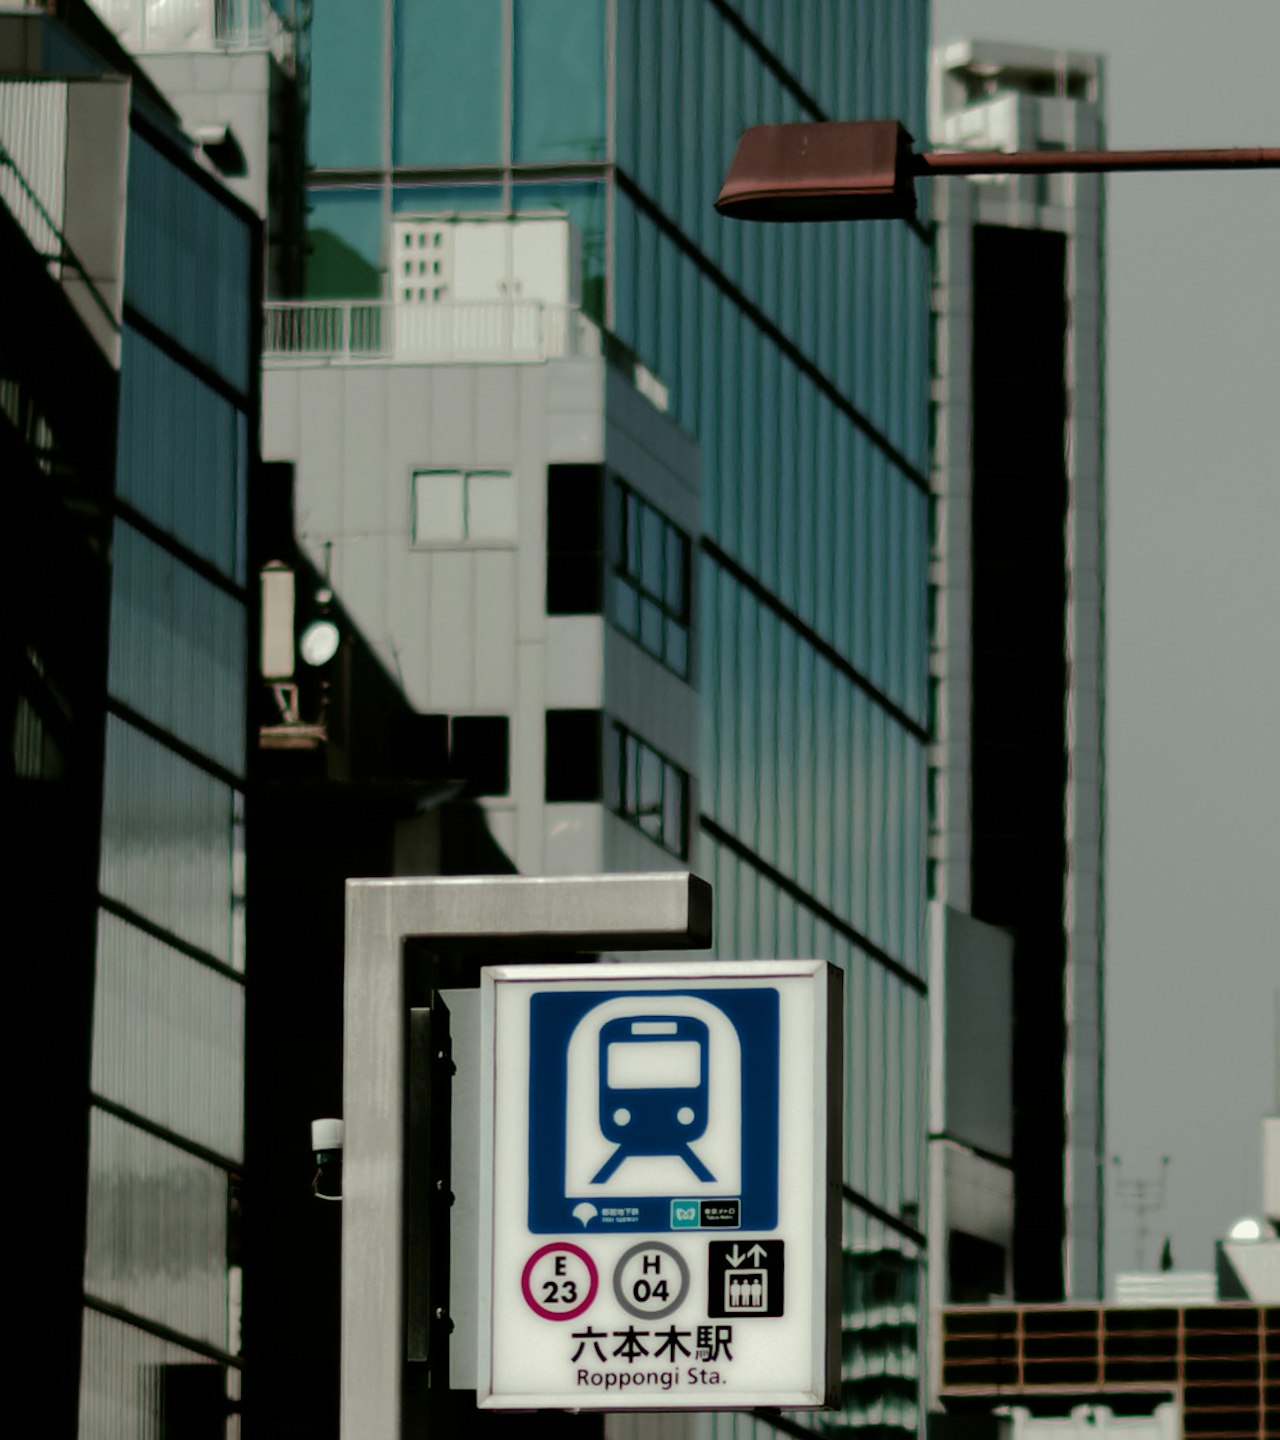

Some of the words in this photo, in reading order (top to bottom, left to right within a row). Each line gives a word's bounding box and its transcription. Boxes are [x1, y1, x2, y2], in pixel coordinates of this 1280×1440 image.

[555, 1256, 566, 1275] E
[643, 1256, 660, 1274] H
[542, 1281, 577, 1303] 23
[633, 1279, 669, 1302] 04
[571, 1324, 733, 1363] 六本木駅
[576, 1367, 680, 1391] Roppongi
[687, 1366, 728, 1386] Sta.
